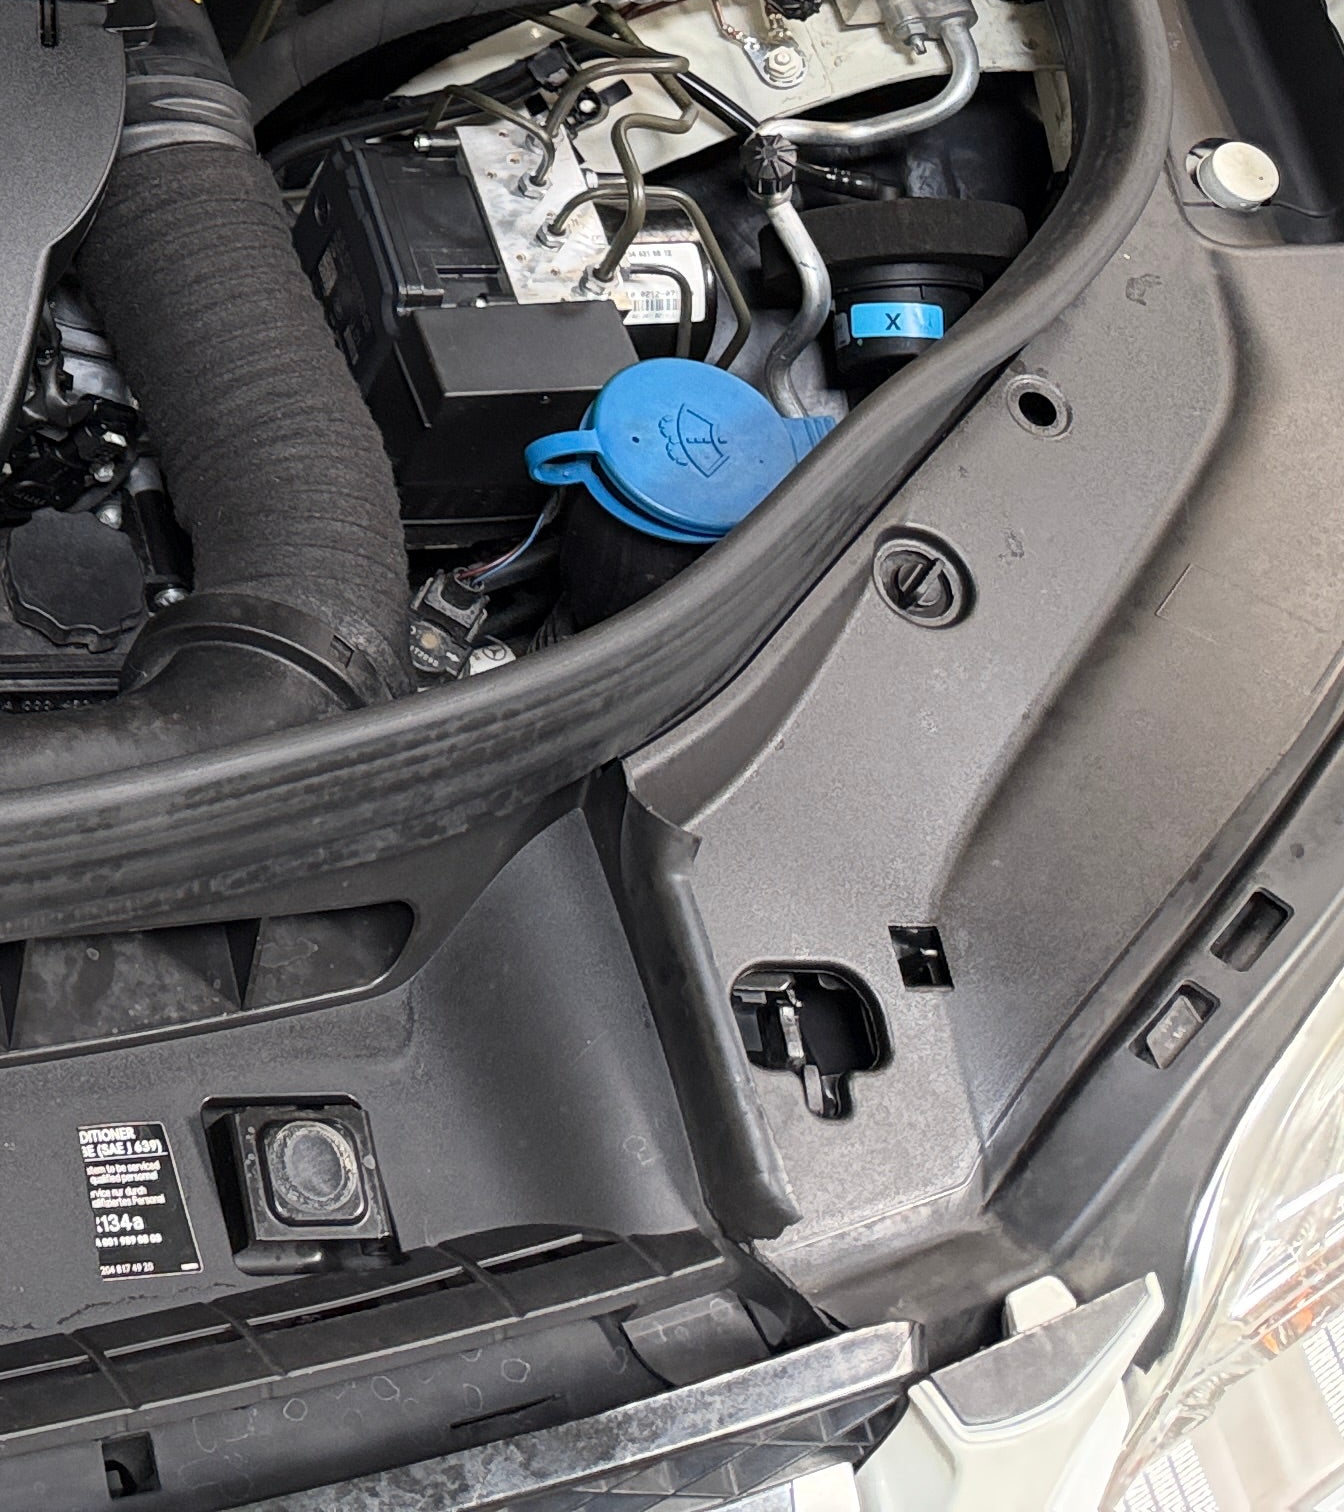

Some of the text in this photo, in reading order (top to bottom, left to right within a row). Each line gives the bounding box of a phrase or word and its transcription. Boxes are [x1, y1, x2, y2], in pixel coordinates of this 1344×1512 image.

[884, 312, 902, 331] X
[78, 1126, 136, 1144] DITIONER
[97, 1141, 125, 1159] (SAE
[134, 1138, 162, 1154] 639)
[127, 1159, 160, 1172] serviced
